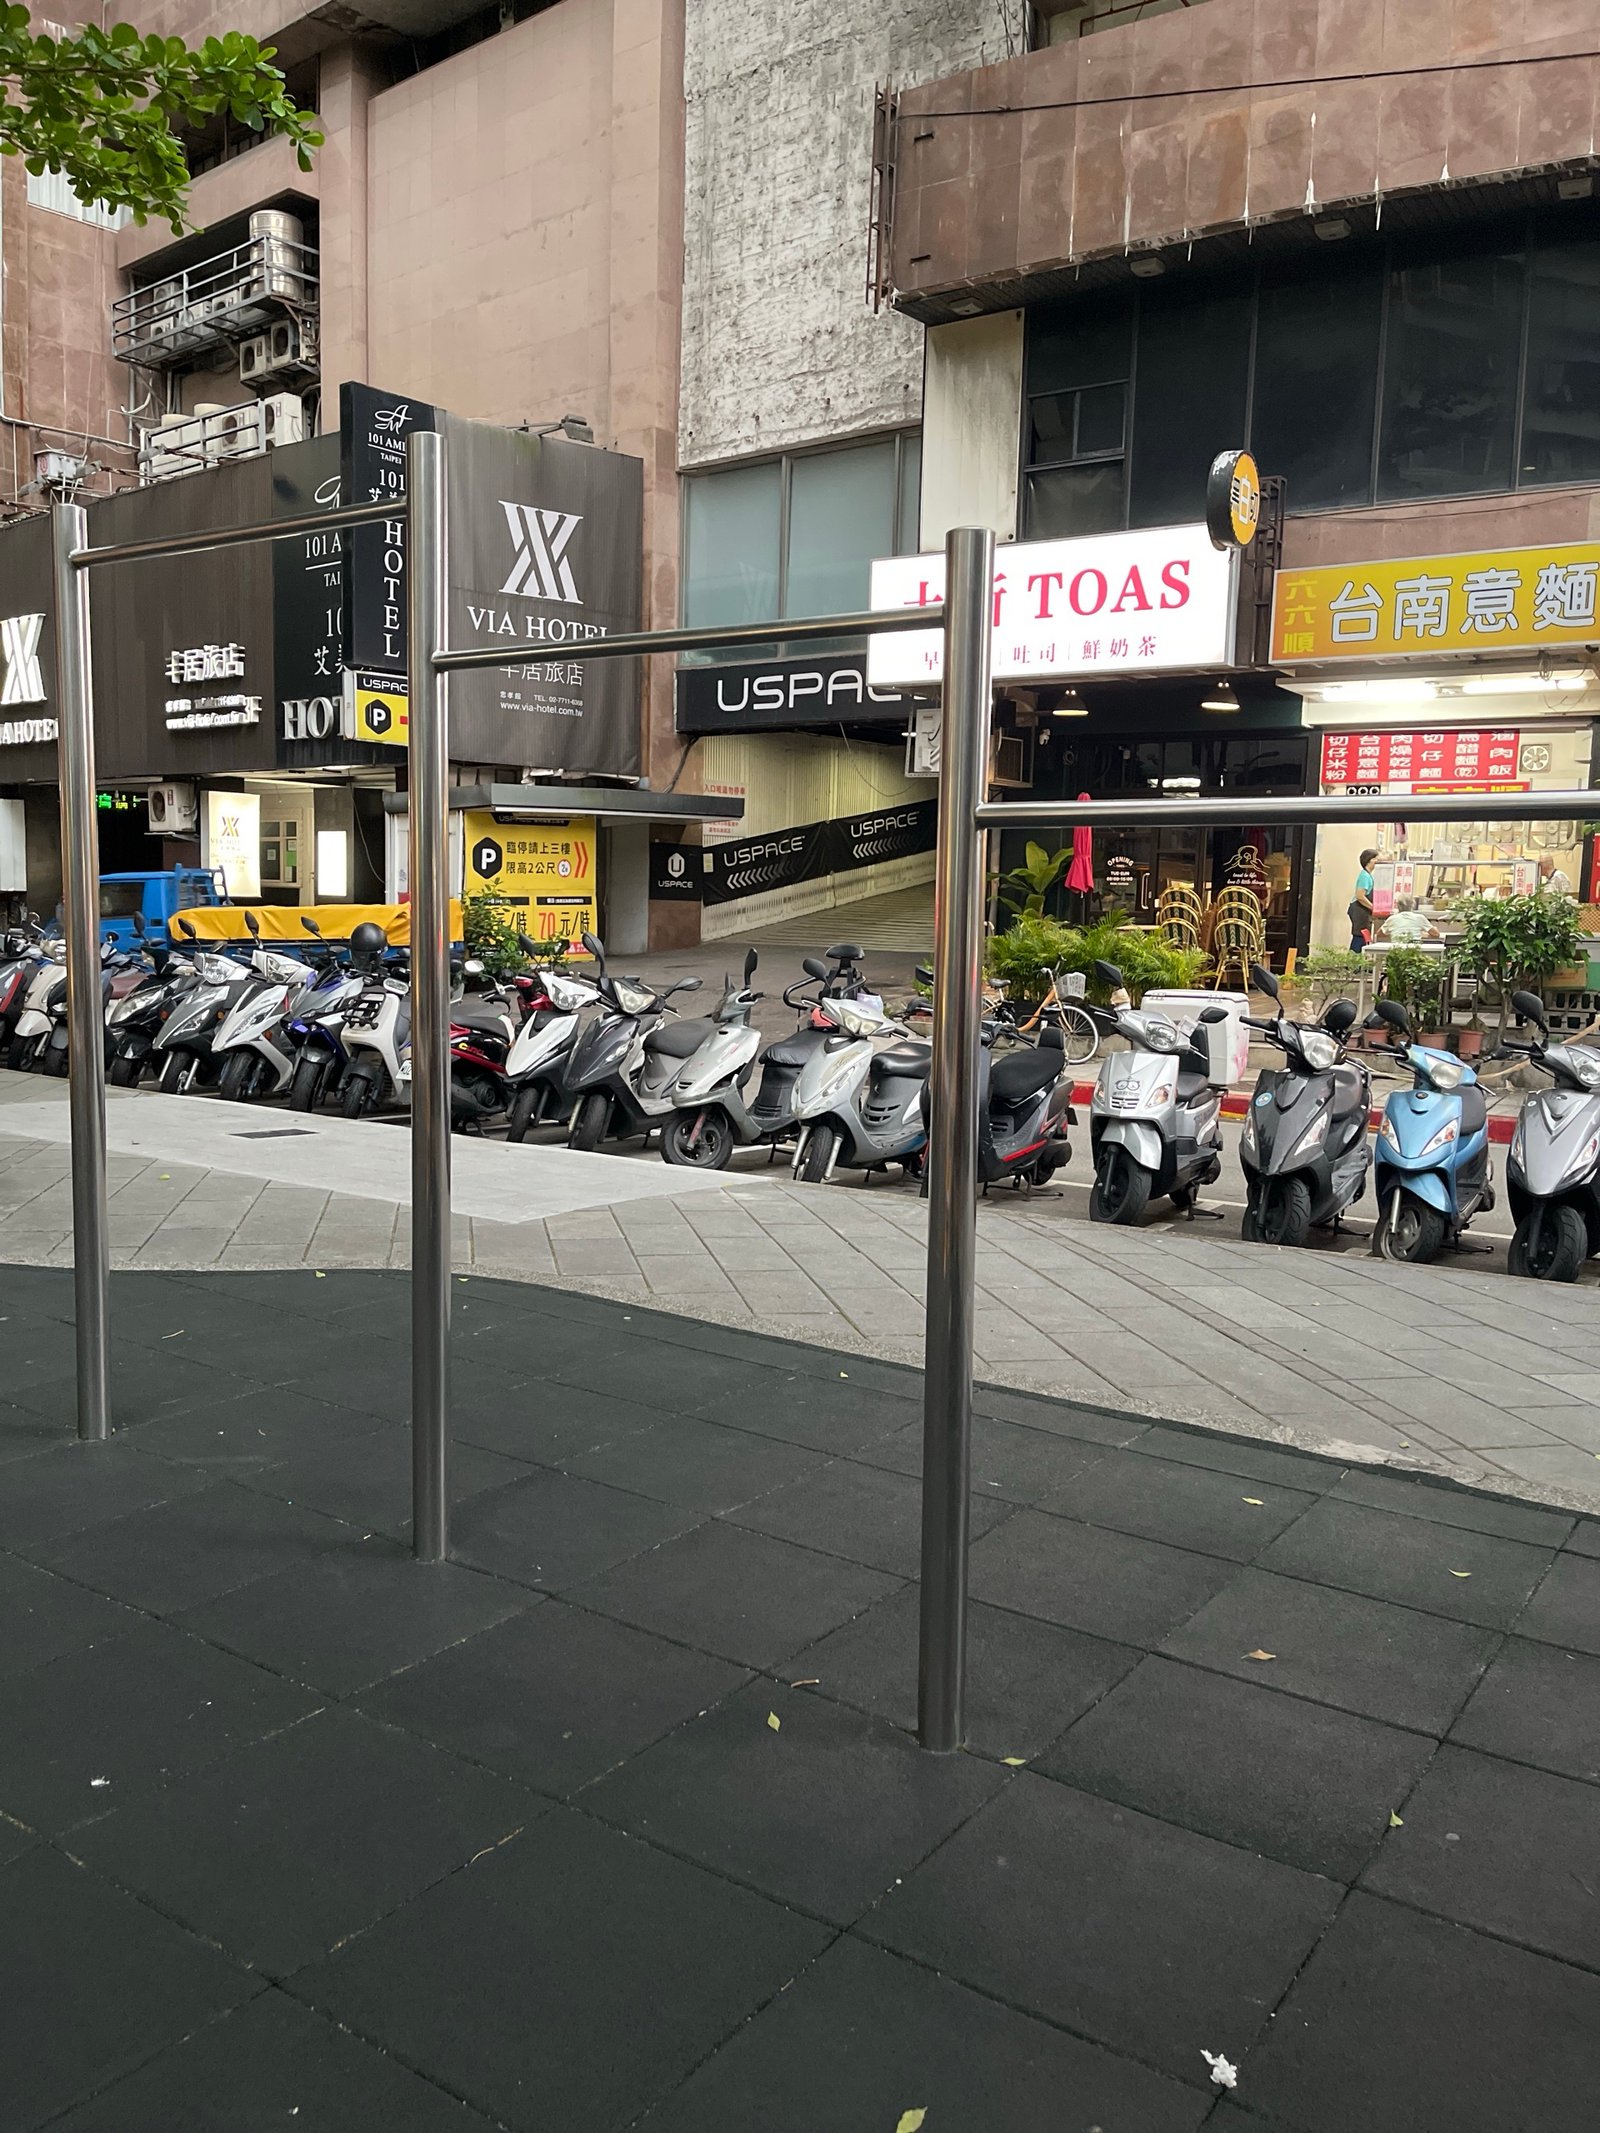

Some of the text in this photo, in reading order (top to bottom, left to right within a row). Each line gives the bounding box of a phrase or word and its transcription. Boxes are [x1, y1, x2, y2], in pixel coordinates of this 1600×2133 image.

[380, 452, 402, 465] TAIPEI
[379, 469, 406, 491] 101
[304, 533, 328, 559] 101
[383, 519, 404, 658] HOTEL
[1028, 559, 1191, 619] TOAS
[1328, 562, 1600, 644] 台南意麵
[466, 605, 518, 636] VIA
[1281, 578, 1318, 654] 六六順
[1012, 642, 1056, 665] 吐司
[1082, 635, 1158, 660] 鮮奶茶
[716, 668, 926, 711] USPA
[372, 707, 387, 727] P
[500, 702, 583, 717] www.via-hotel.com.tw
[1325, 735, 1350, 781] 切仔米粉
[1356, 735, 1381, 780] 台南意麵
[1419, 733, 1445, 779] 切仔麵
[850, 812, 918, 838] USPACE
[481, 847, 497, 870] P
[506, 841, 571, 855] 臨停請上三樓
[723, 836, 804, 867] USPACE
[1107, 855, 1135, 867] OPENING
[506, 861, 556, 875] 限高2公尺
[658, 879, 694, 889] USPACE
[538, 911, 556, 940] 70
